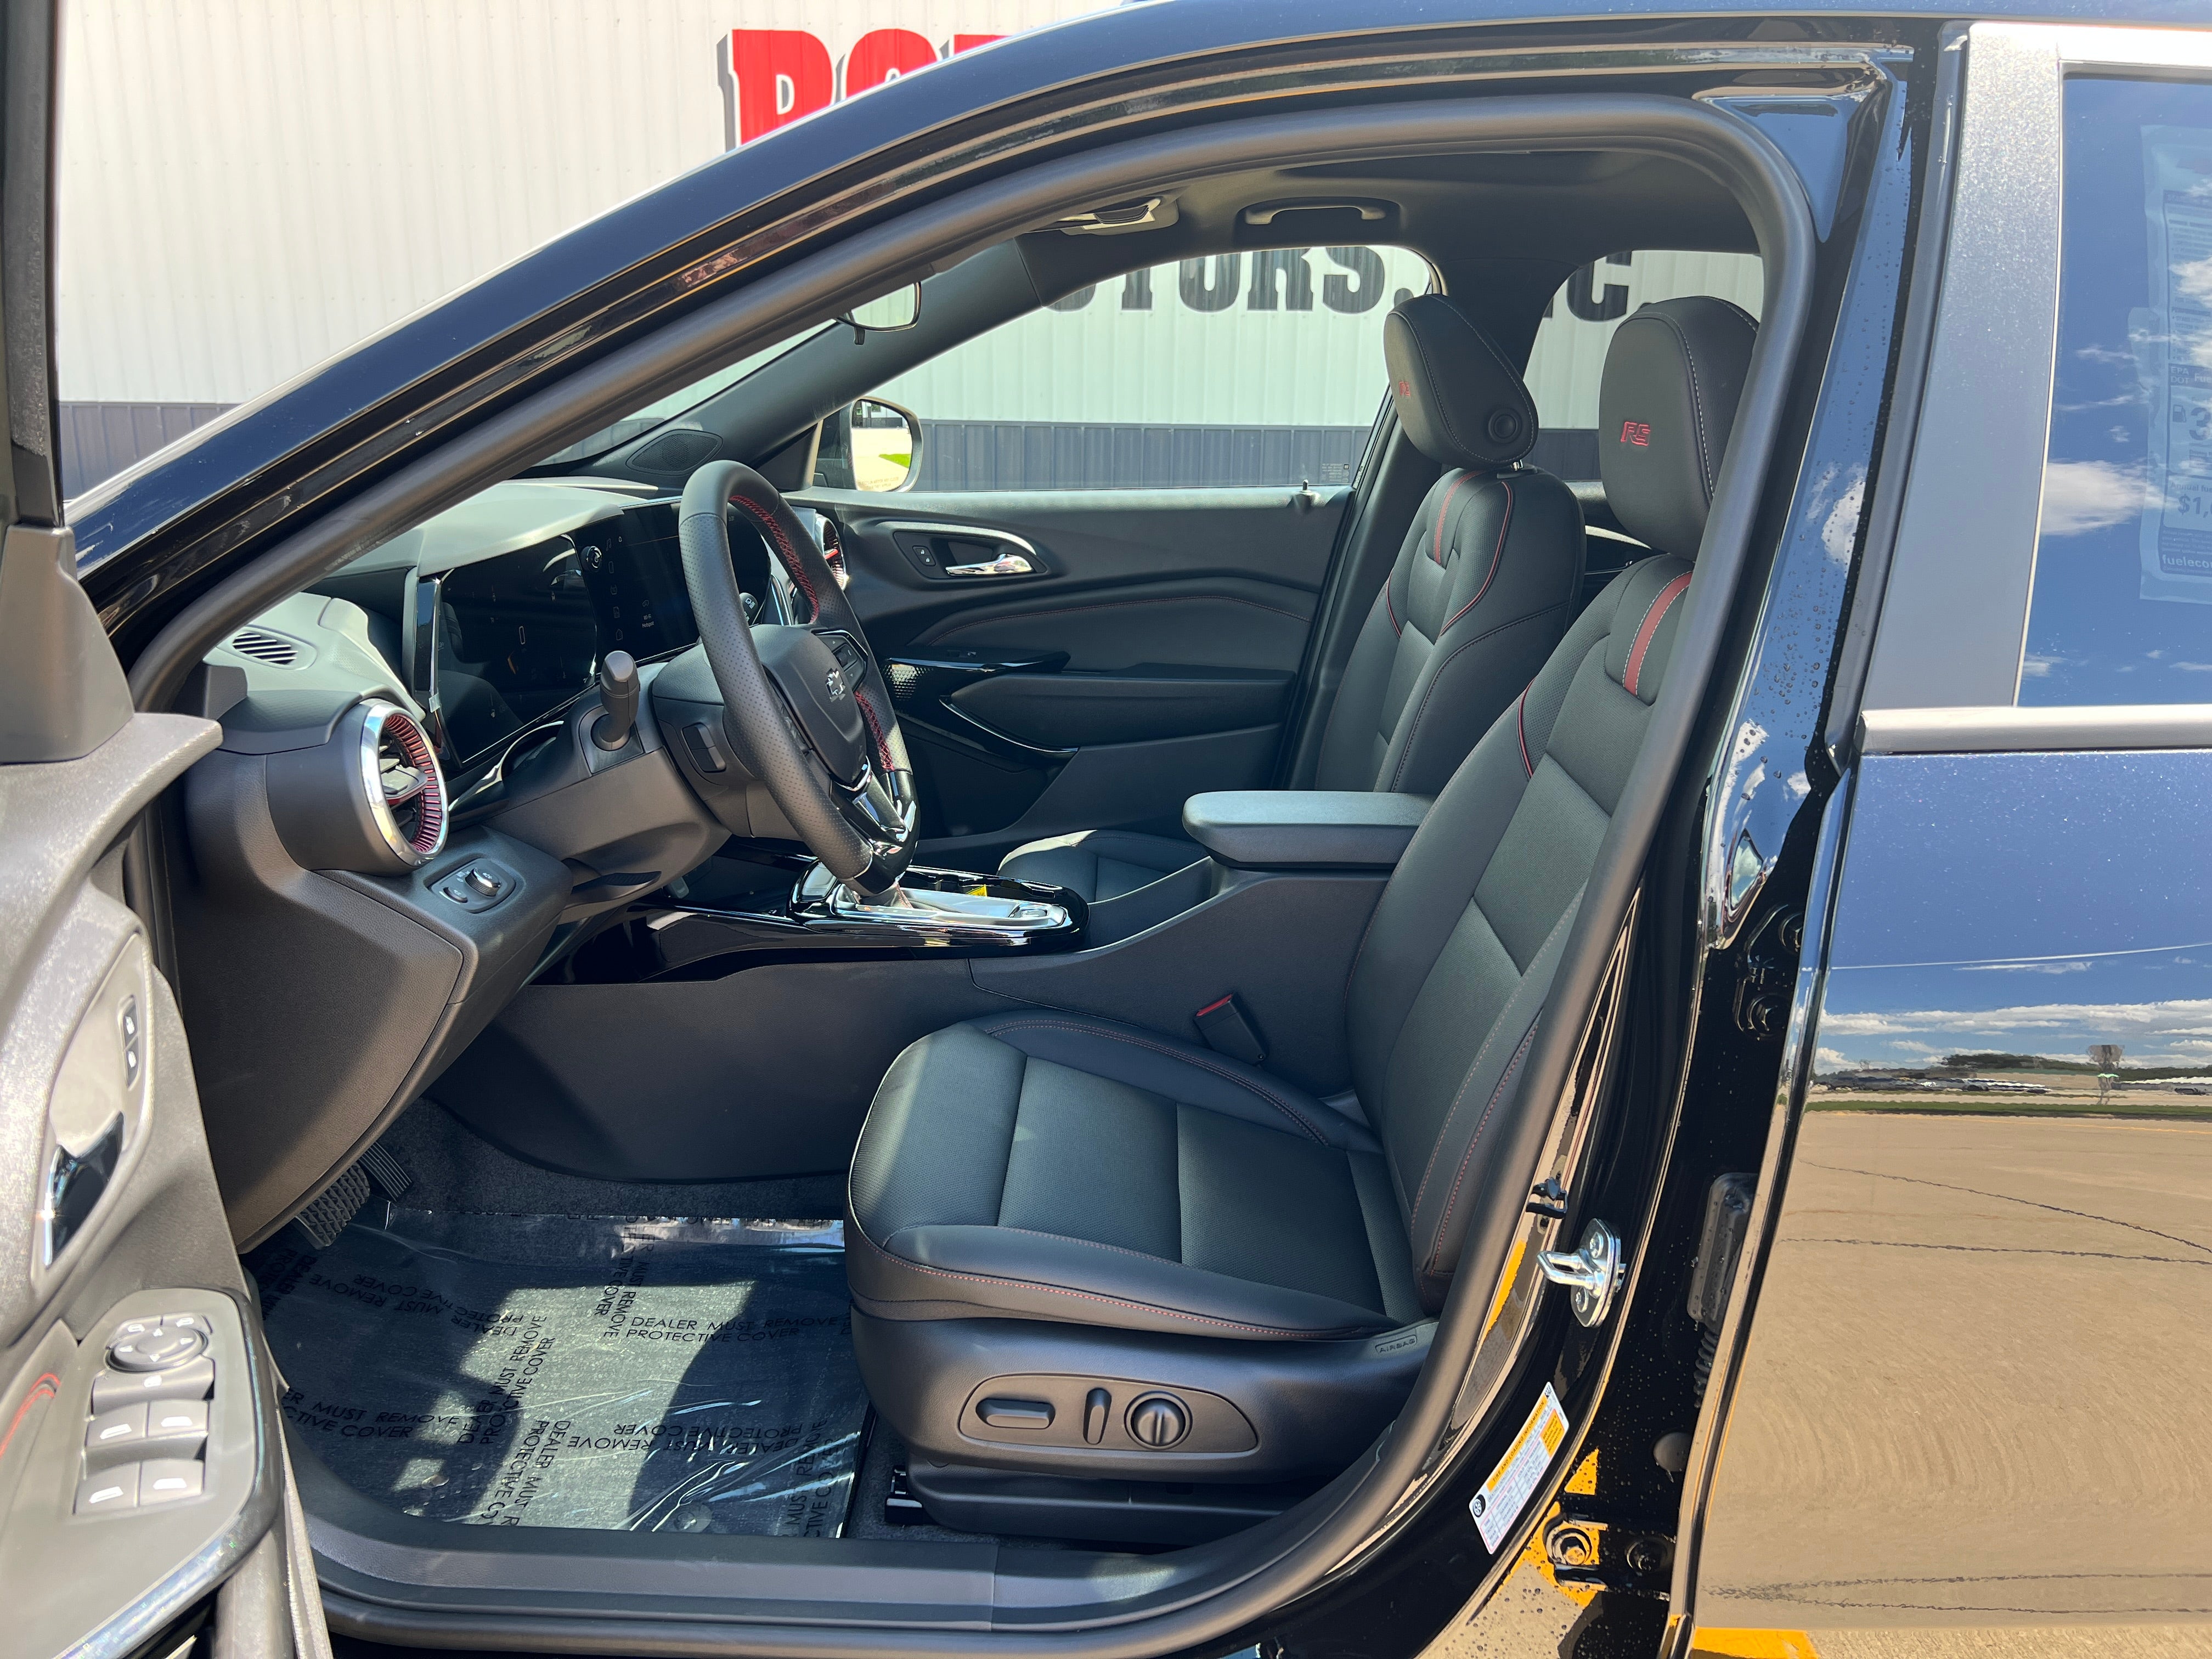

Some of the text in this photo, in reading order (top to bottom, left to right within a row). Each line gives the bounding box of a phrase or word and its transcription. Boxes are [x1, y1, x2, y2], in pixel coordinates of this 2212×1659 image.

[2170, 366, 2190, 376] EPA
[2170, 375, 2190, 385] DOT
[1621, 421, 1651, 447] RS
[2177, 494, 2212, 518] $1,
[2162, 554, 2212, 570] fueleco
[352, 1273, 417, 1297] COVER
[309, 1273, 518, 1337] DEALER MUST REMOVE
[594, 1279, 623, 1316] COVER
[603, 1291, 637, 1338] REMOVE
[630, 1317, 698, 1330] DEALER
[707, 1321, 754, 1331] MUST
[763, 1317, 838, 1328] REMOVE
[626, 1327, 800, 1342] PROTECTIVE COVER
[1379, 1338, 1415, 1353] AIRBAG
[488, 1367, 518, 1395] MUST
[509, 1316, 548, 1362] REMOVE
[523, 1338, 556, 1375] COVER
[312, 1401, 368, 1421] MUST
[374, 1412, 460, 1425] REMOVE
[340, 1425, 413, 1438] COVER
[613, 1424, 803, 1438] PROTECTIVE COVER
[1492, 1470, 1500, 1483] TIRE
[1500, 1457, 1509, 1471] AND
[1508, 1435, 1523, 1460] LOADING
[1523, 1400, 1544, 1437] INFORMATION
[567, 1436, 653, 1452] REMOVE
[494, 1420, 550, 1498] PROTECTIVE
[514, 1420, 572, 1508] DEALER MUST
